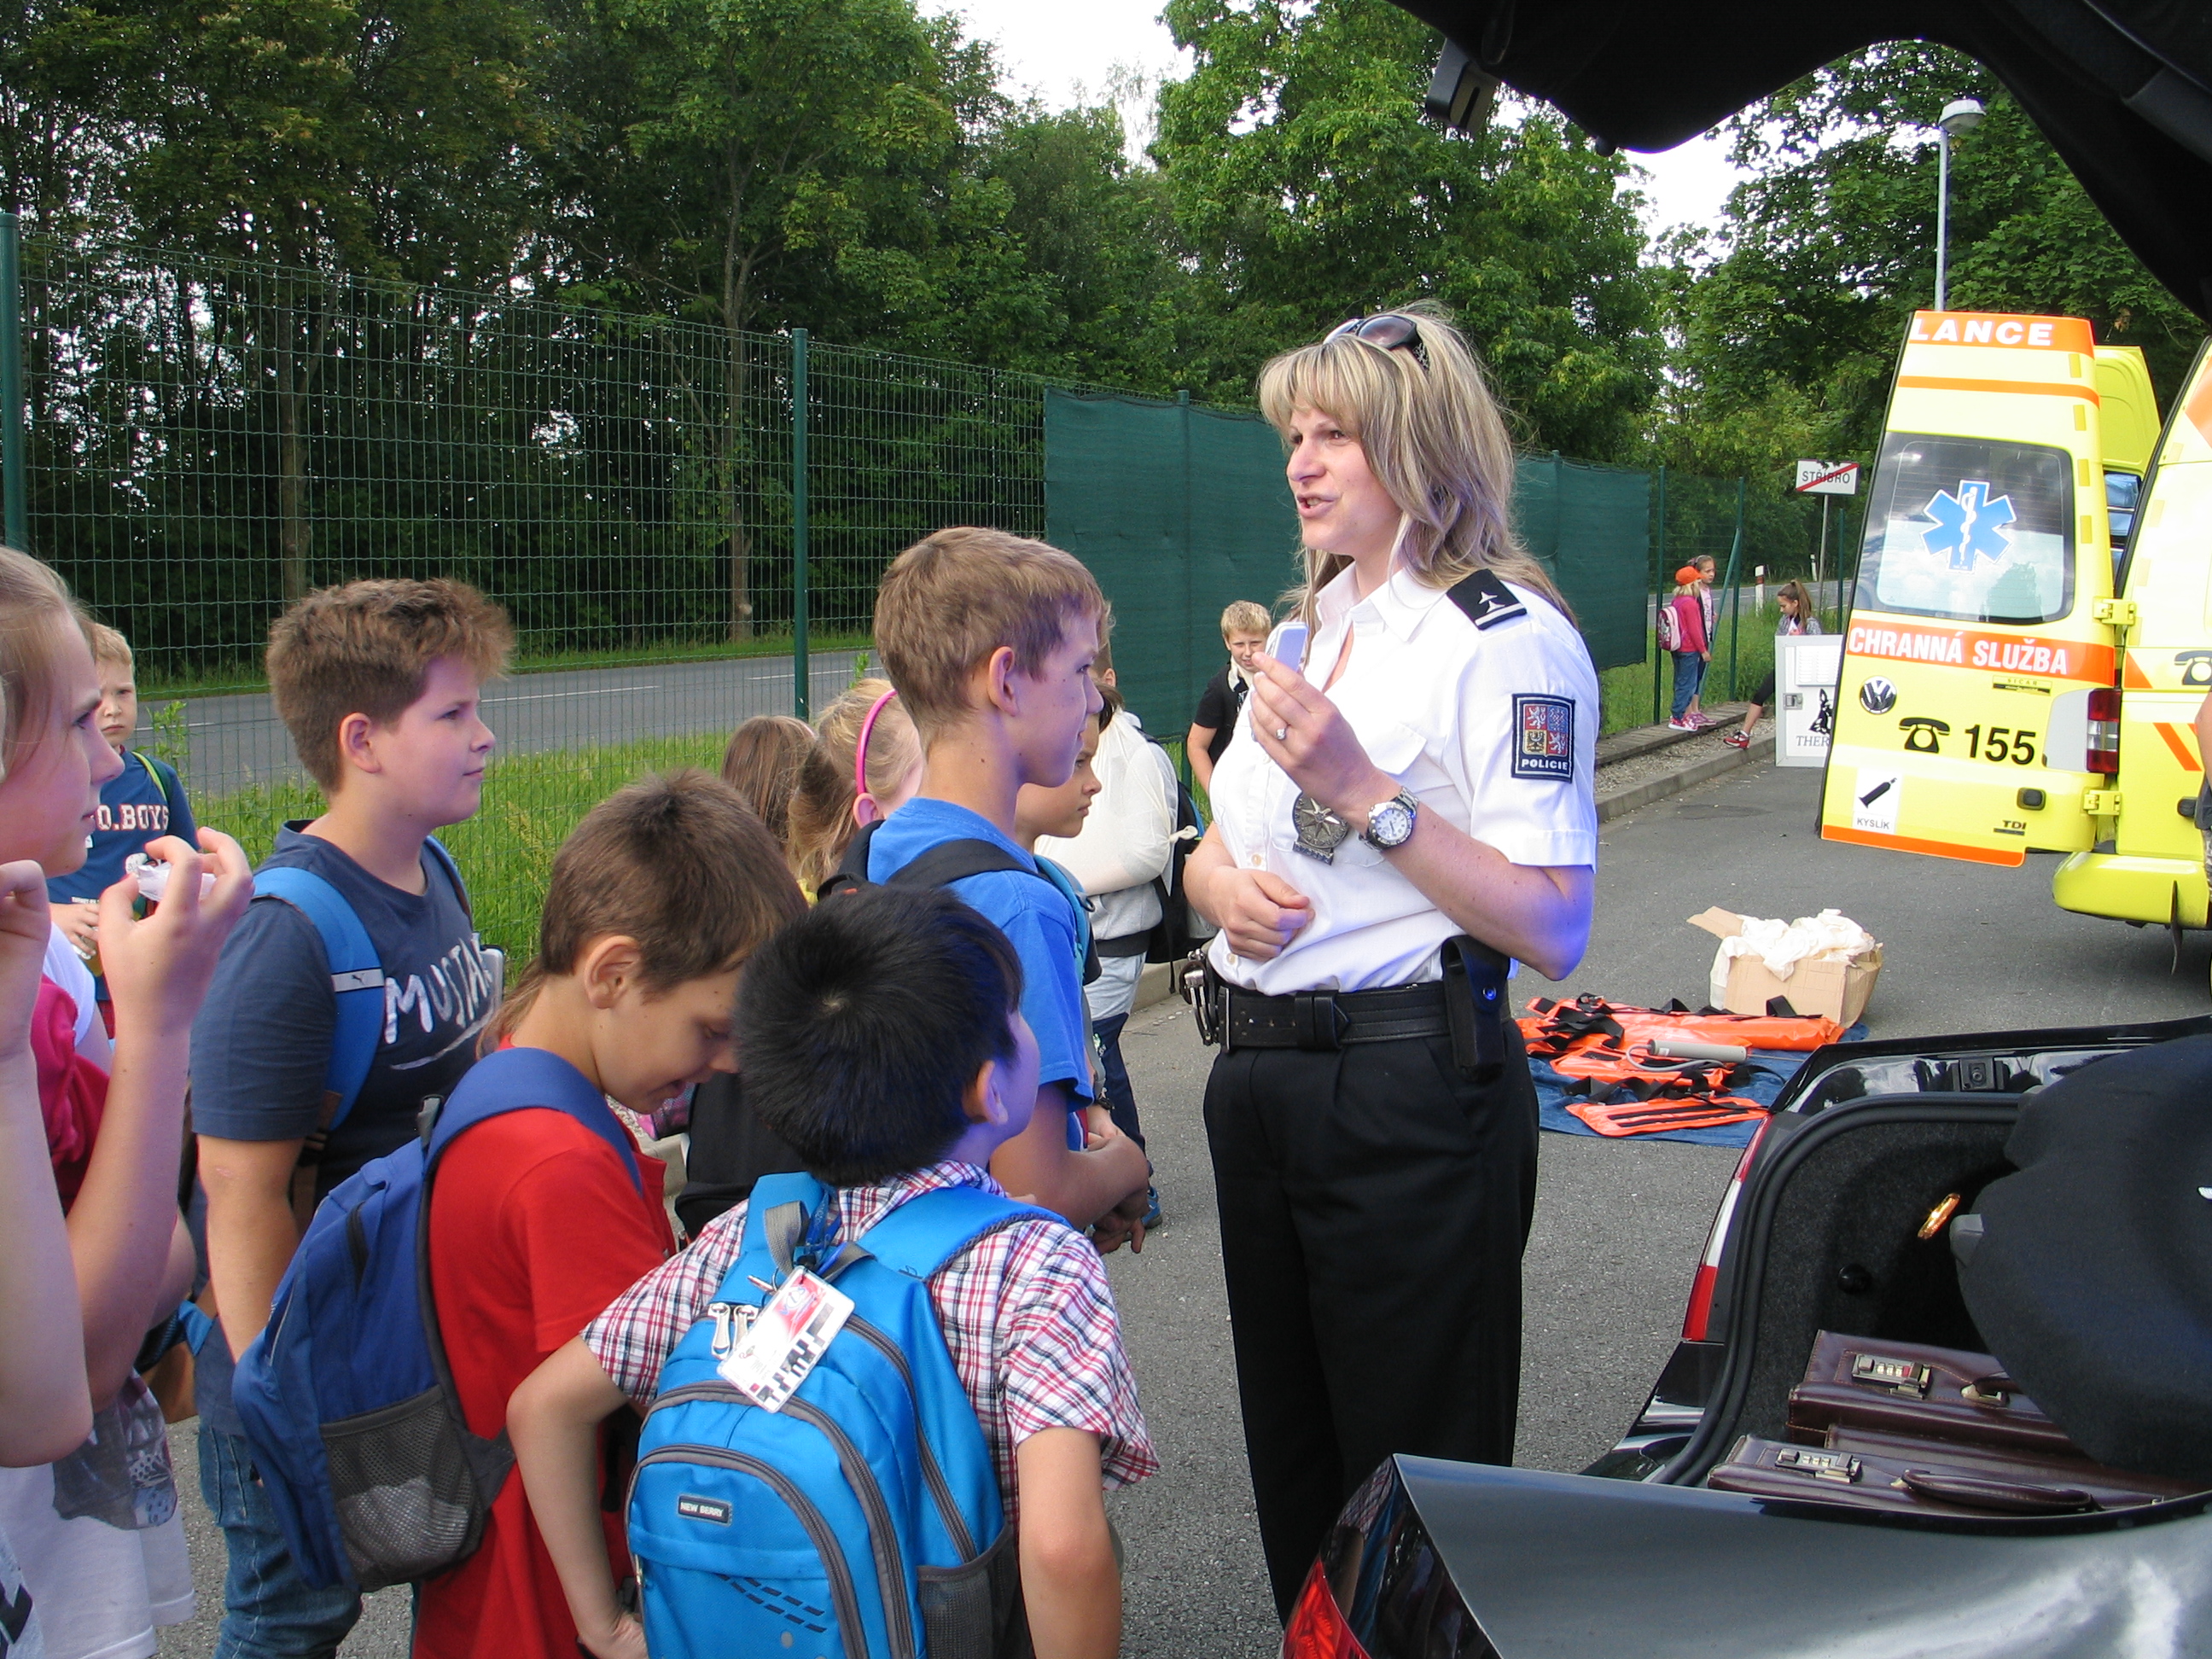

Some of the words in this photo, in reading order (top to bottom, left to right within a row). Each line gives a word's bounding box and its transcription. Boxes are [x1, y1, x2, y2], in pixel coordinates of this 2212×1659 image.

[1908, 318, 2053, 346] LANCE
[1848, 627, 1963, 664] CHRANNÁ
[1972, 638, 2068, 675] SLUŽBA
[1965, 724, 2036, 765] 155
[1521, 759, 1569, 771] POLICIE
[1857, 818, 1890, 830] KYSLÍK
[2002, 820, 2027, 830] TDI
